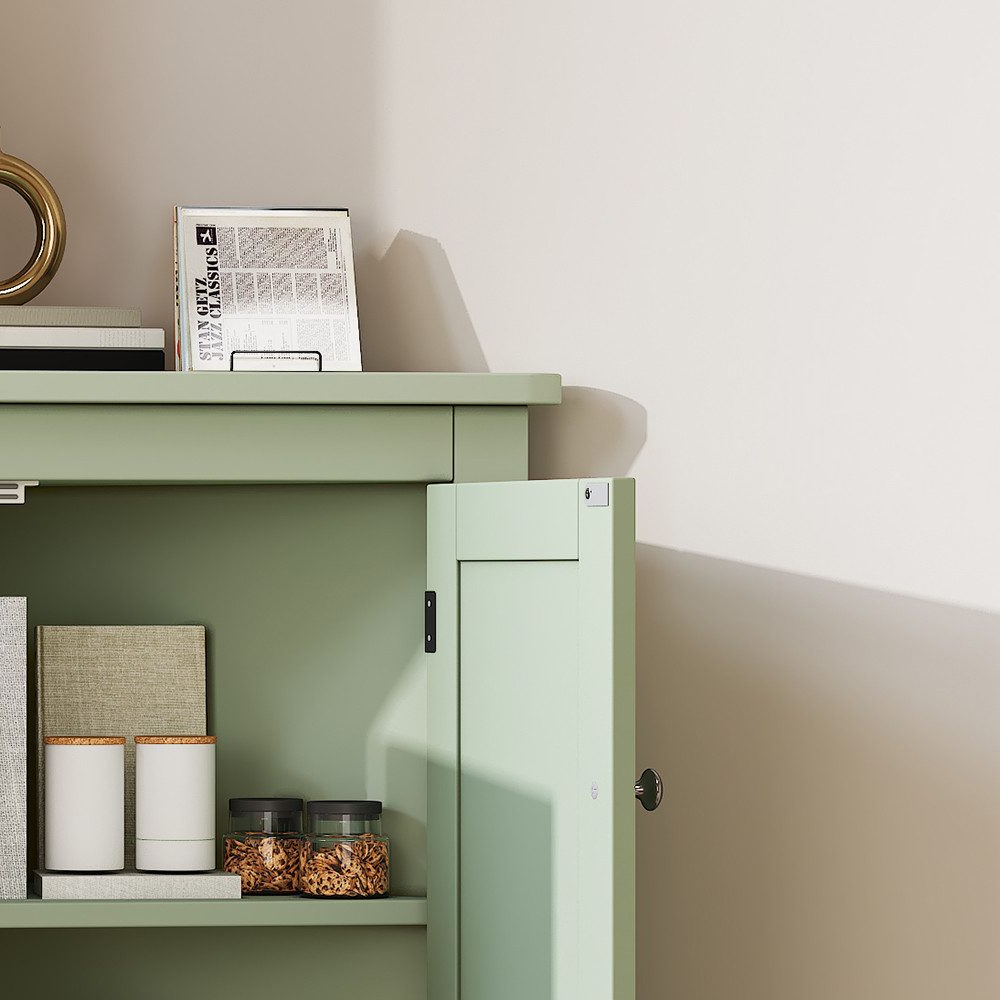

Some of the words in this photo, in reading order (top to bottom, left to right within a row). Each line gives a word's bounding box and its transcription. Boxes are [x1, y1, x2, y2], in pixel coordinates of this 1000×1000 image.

[195, 277, 209, 316] GETZ
[206, 247, 222, 319] CLASSICS
[198, 320, 211, 361] STAN
[210, 322, 224, 361] JAZZ
